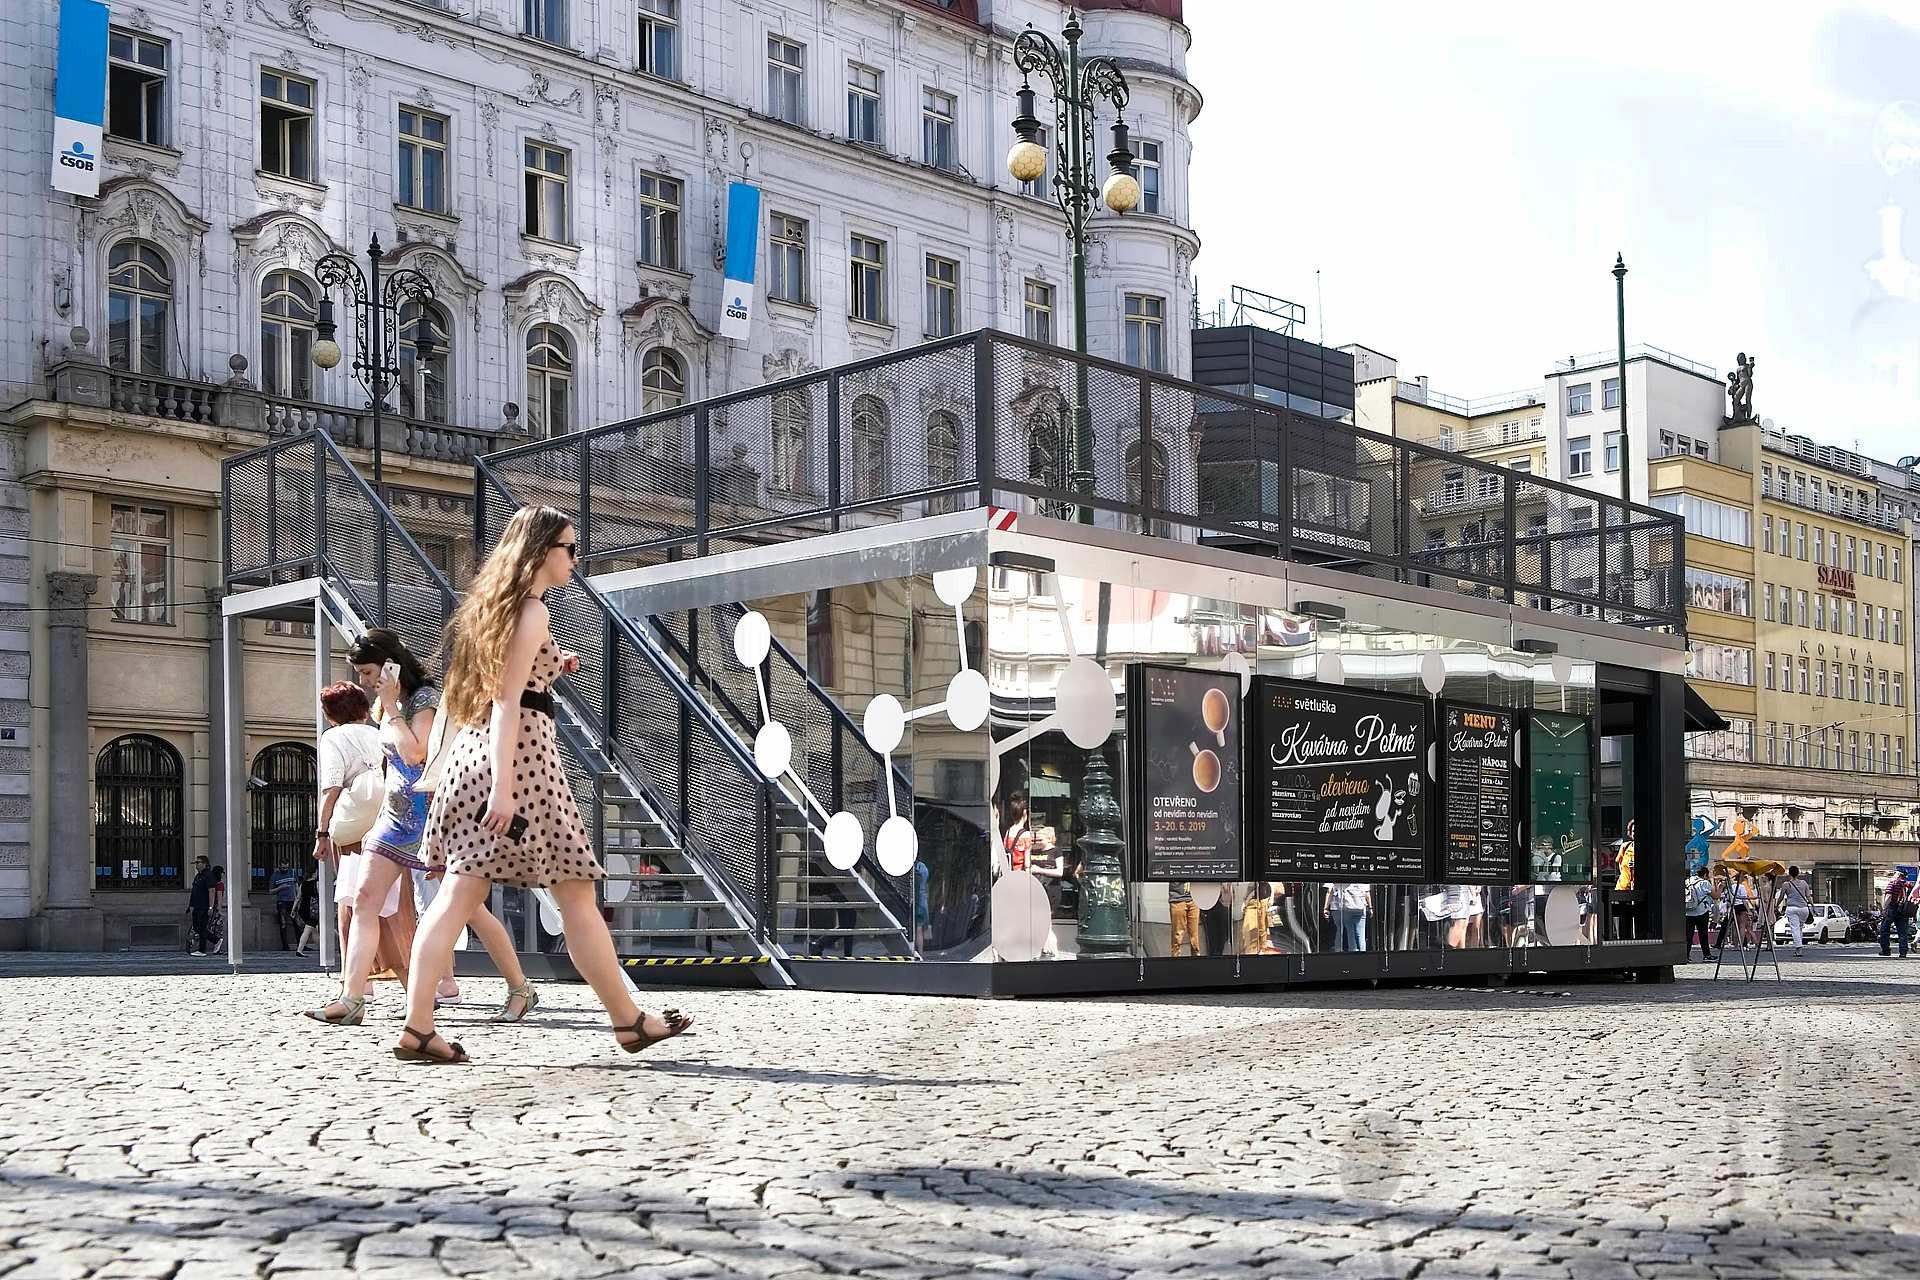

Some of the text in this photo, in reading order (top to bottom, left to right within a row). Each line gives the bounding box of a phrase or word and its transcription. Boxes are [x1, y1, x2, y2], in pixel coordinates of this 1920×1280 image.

[60, 155, 94, 171] ČSOB
[1817, 565, 1856, 590] SLAVIA
[1800, 640, 1873, 665] KOTVA
[1294, 698, 1336, 713] světluška
[1463, 713, 1496, 729] MENU
[1270, 713, 1417, 764] Kavárna Potmě
[1320, 770, 1369, 797] otevřeno
[1153, 796, 1197, 808] OTEVŘENO
[1153, 809, 1163, 818] od
[1188, 810, 1196, 818] do
[1188, 821, 1206, 832] 2019
